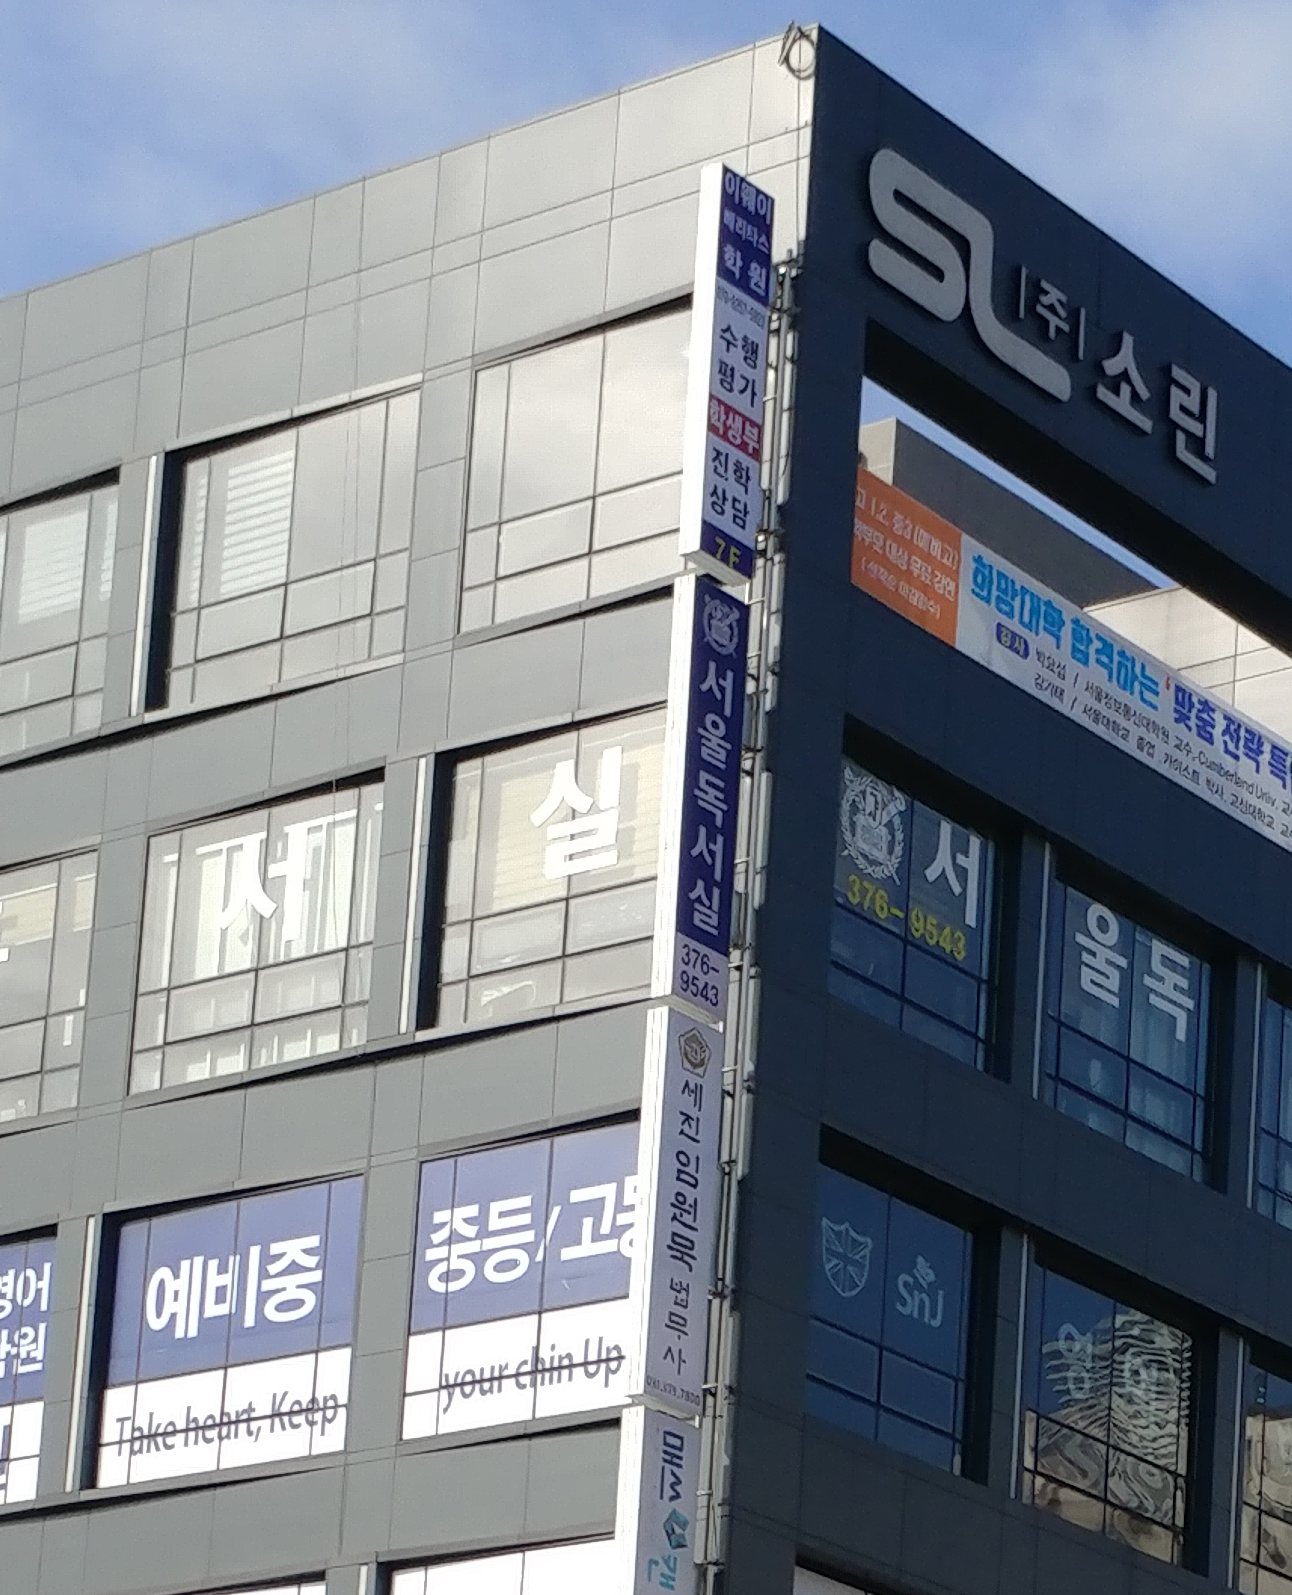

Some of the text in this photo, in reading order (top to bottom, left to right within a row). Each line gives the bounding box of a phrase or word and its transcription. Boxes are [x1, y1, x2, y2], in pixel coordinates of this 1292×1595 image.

[719, 322, 759, 371] 수행
[717, 359, 758, 407] 평가
[1094, 329, 1218, 485] 소린
[709, 399, 761, 456] 학생부
[711, 446, 753, 495] 진학
[709, 481, 751, 532] 상담
[714, 536, 741, 567] 7F
[971, 554, 1065, 650] 희망대학
[1071, 616, 1160, 711] 합격하는
[1221, 711, 1264, 774] 전략
[688, 660, 734, 936] 서울독서실
[145, 1234, 324, 1340] 예비중
[443, 1337, 623, 1415] your chin Up
[114, 1414, 179, 1459] Take
[270, 1389, 340, 1437] Keep
